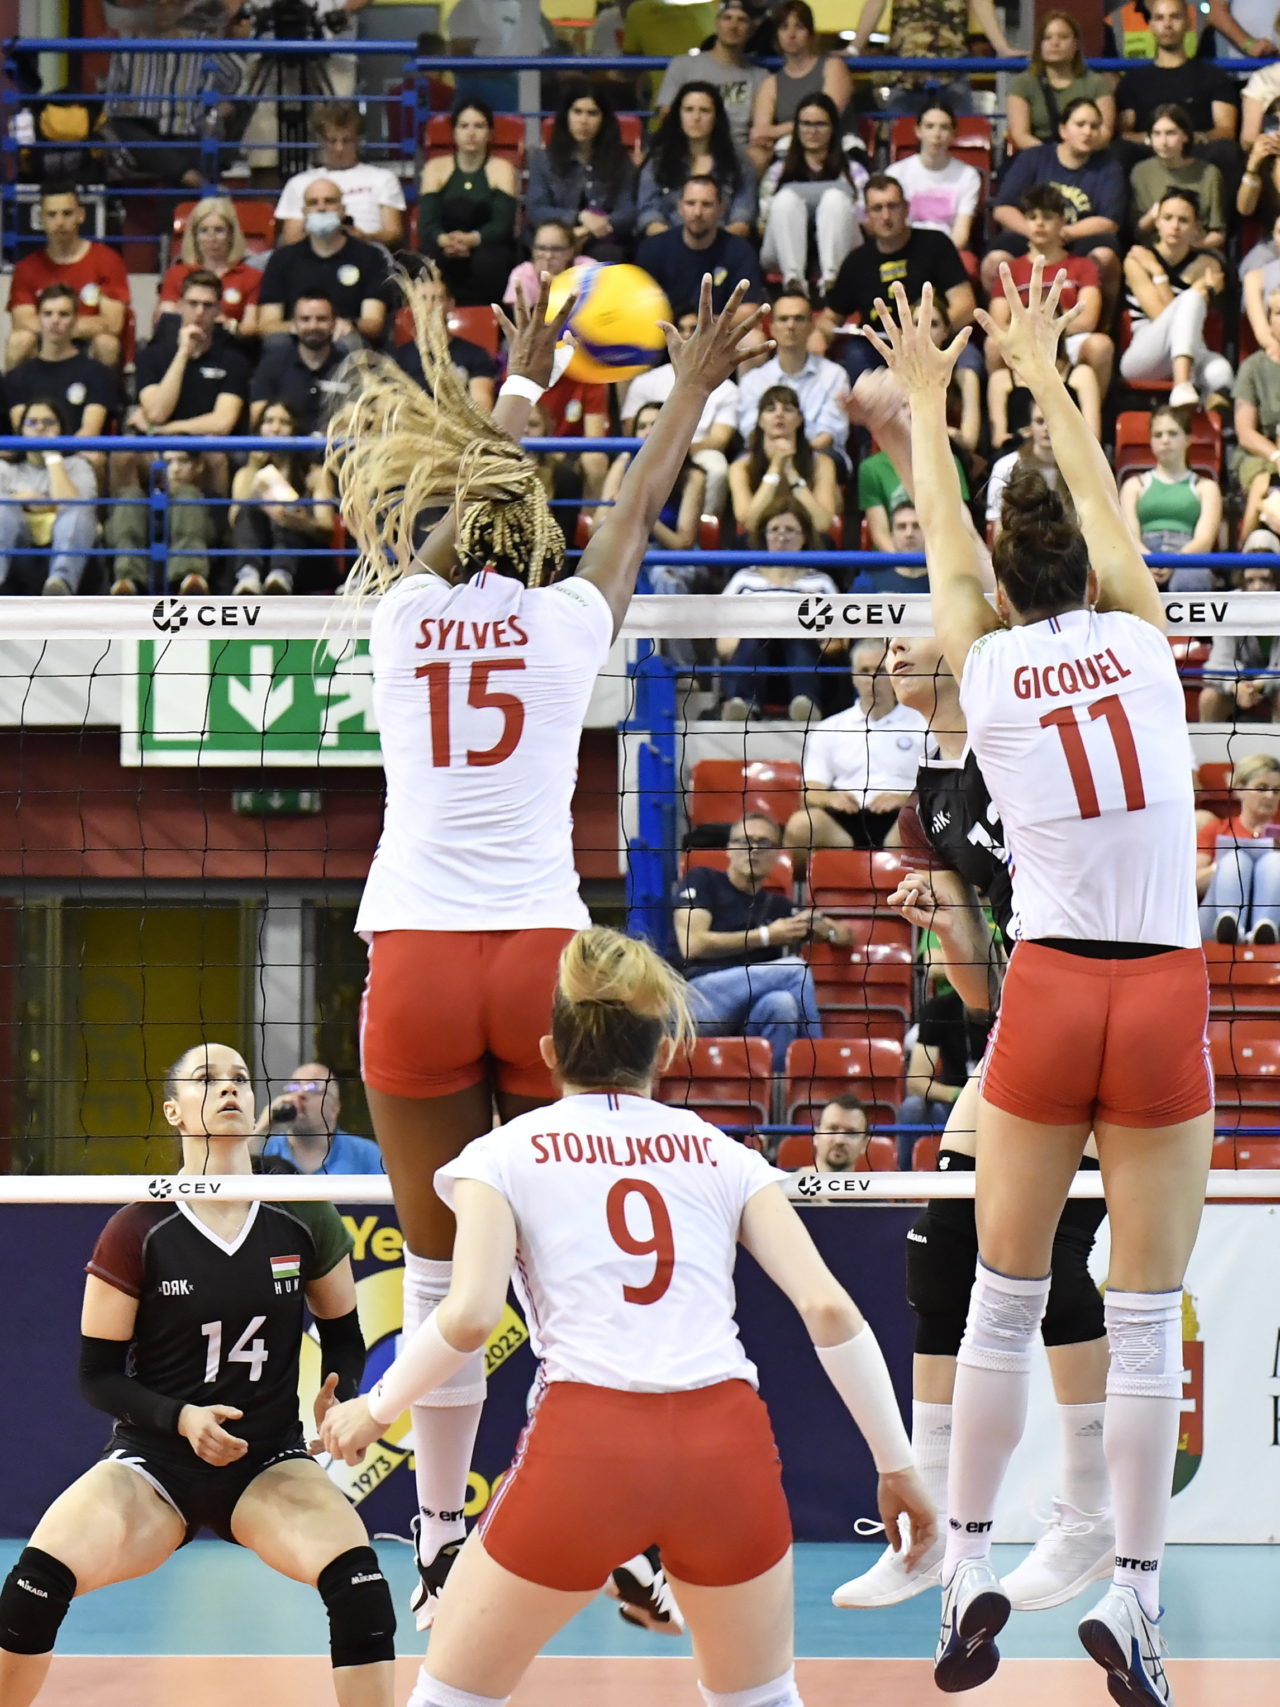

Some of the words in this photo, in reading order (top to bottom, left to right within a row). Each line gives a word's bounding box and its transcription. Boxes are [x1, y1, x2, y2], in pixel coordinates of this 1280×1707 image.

[197, 605, 262, 627] CEV
[842, 603, 907, 625] CEV
[1164, 601, 1229, 623] CEV
[414, 613, 530, 651] SYLVES
[1013, 646, 1132, 700] GICQUEL
[414, 657, 527, 768] 15
[1038, 693, 1146, 820] 11
[530, 1131, 718, 1168] STOJILJKOVIC
[178, 1182, 222, 1195] CEV
[827, 1179, 871, 1192] CEV
[605, 1177, 676, 1306] 9
[200, 1315, 269, 1384] 14
[484, 1324, 523, 1370] 2023
[351, 1455, 392, 1494] 1973
